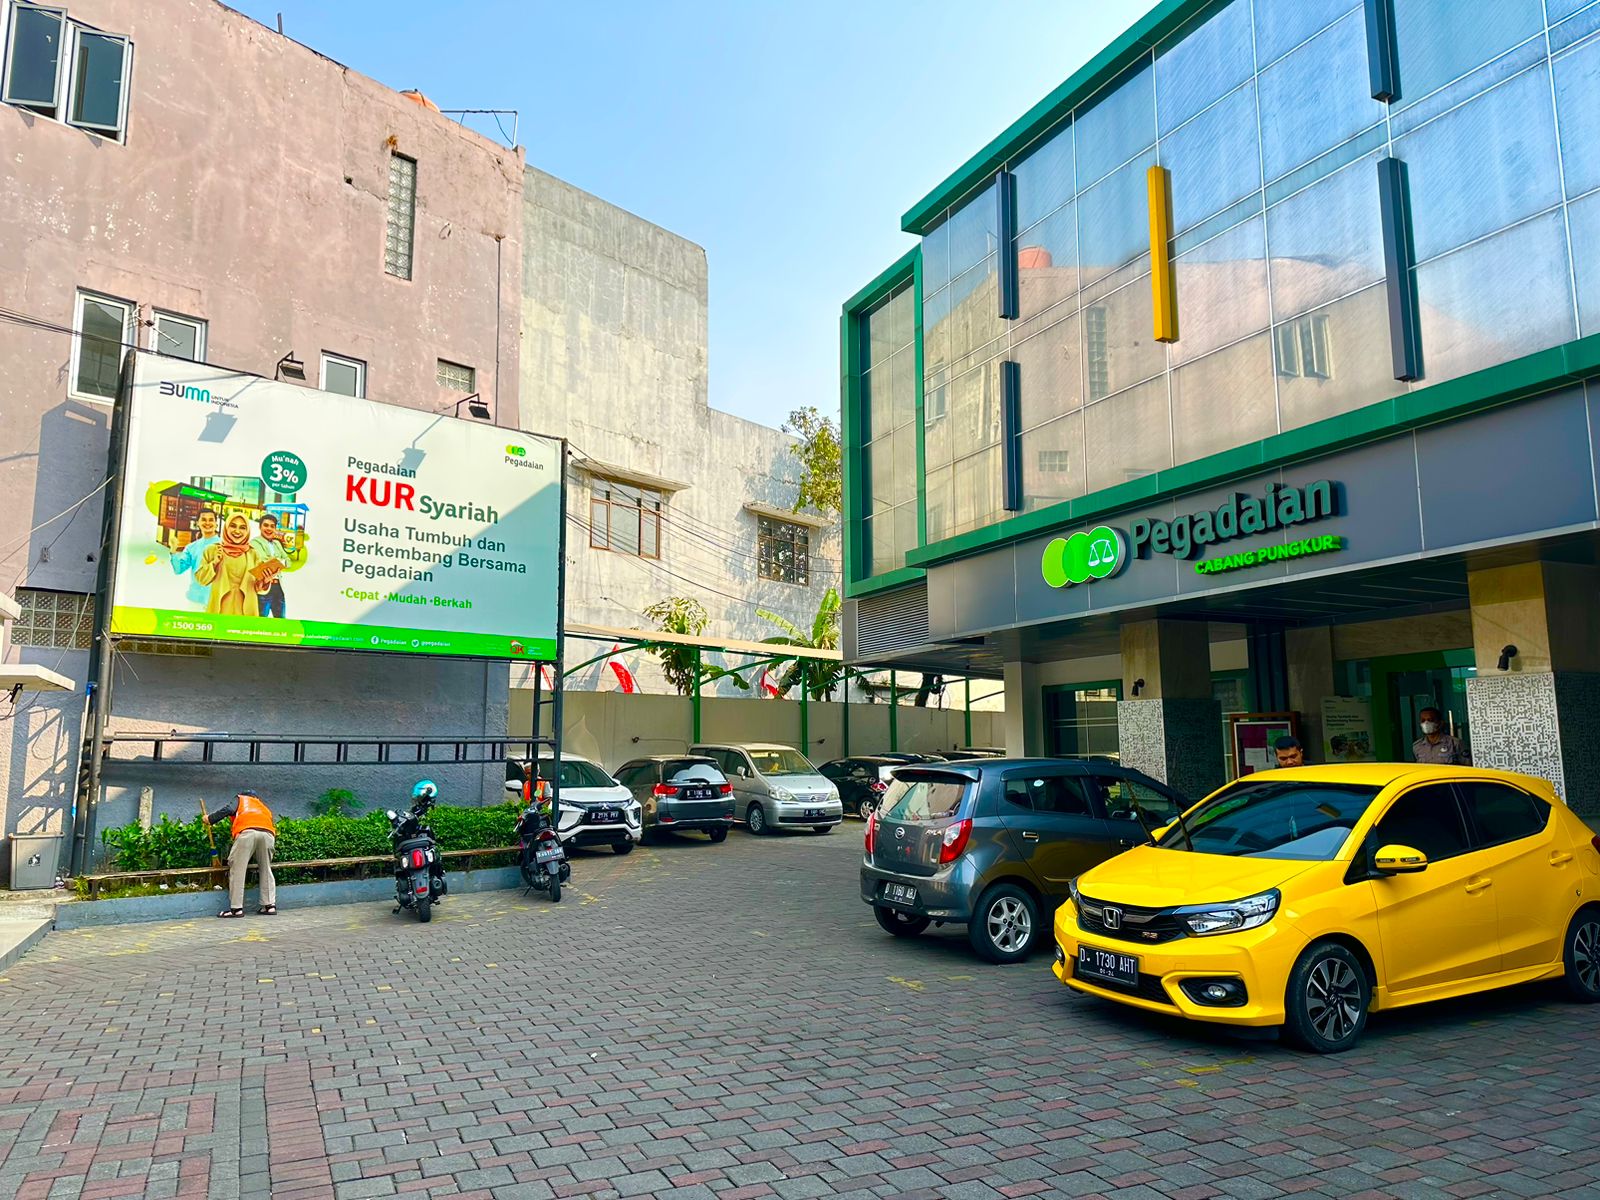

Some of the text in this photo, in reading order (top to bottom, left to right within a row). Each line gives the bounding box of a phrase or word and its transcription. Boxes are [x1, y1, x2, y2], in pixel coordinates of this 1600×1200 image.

[269, 463, 299, 484] 3%
[347, 456, 417, 479] Pegadaian
[504, 455, 544, 470] Pegadaian
[345, 474, 499, 524] KUR Syariah
[1128, 478, 1339, 560] Pegadaian
[344, 517, 506, 553] Usaha Tumbuh dan
[342, 538, 527, 574] Berkembang Bersama
[1194, 534, 1342, 575] CABANG PUNGKUR
[341, 559, 433, 582] Pegadaian
[172, 621, 213, 631] 1500 569
[1095, 951, 1116, 970] 1730
[1119, 956, 1135, 974] AHT
